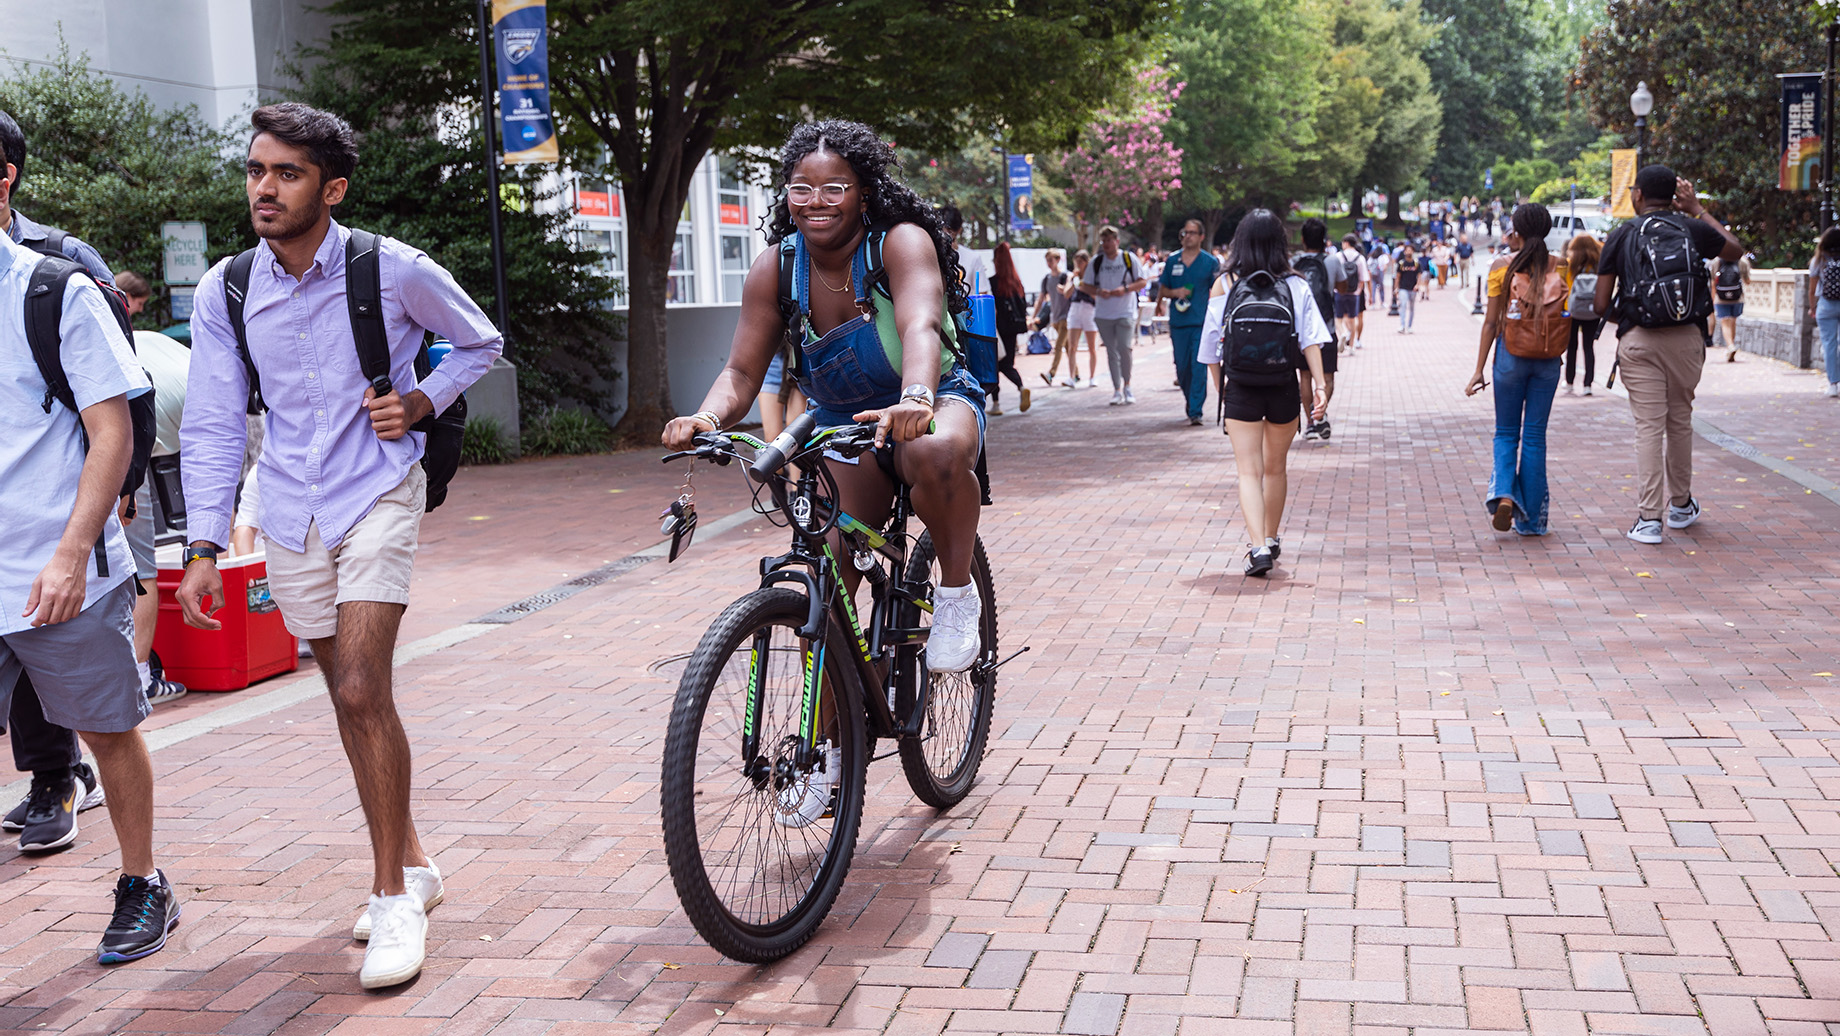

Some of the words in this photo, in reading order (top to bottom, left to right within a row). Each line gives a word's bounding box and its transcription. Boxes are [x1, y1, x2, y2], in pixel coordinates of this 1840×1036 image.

[520, 98, 533, 108] 31
[1802, 92, 1814, 128] PRIDE
[1787, 103, 1801, 167] TOGETHER
[174, 254, 196, 266] HERE
[800, 651, 814, 739] SCHWINN
